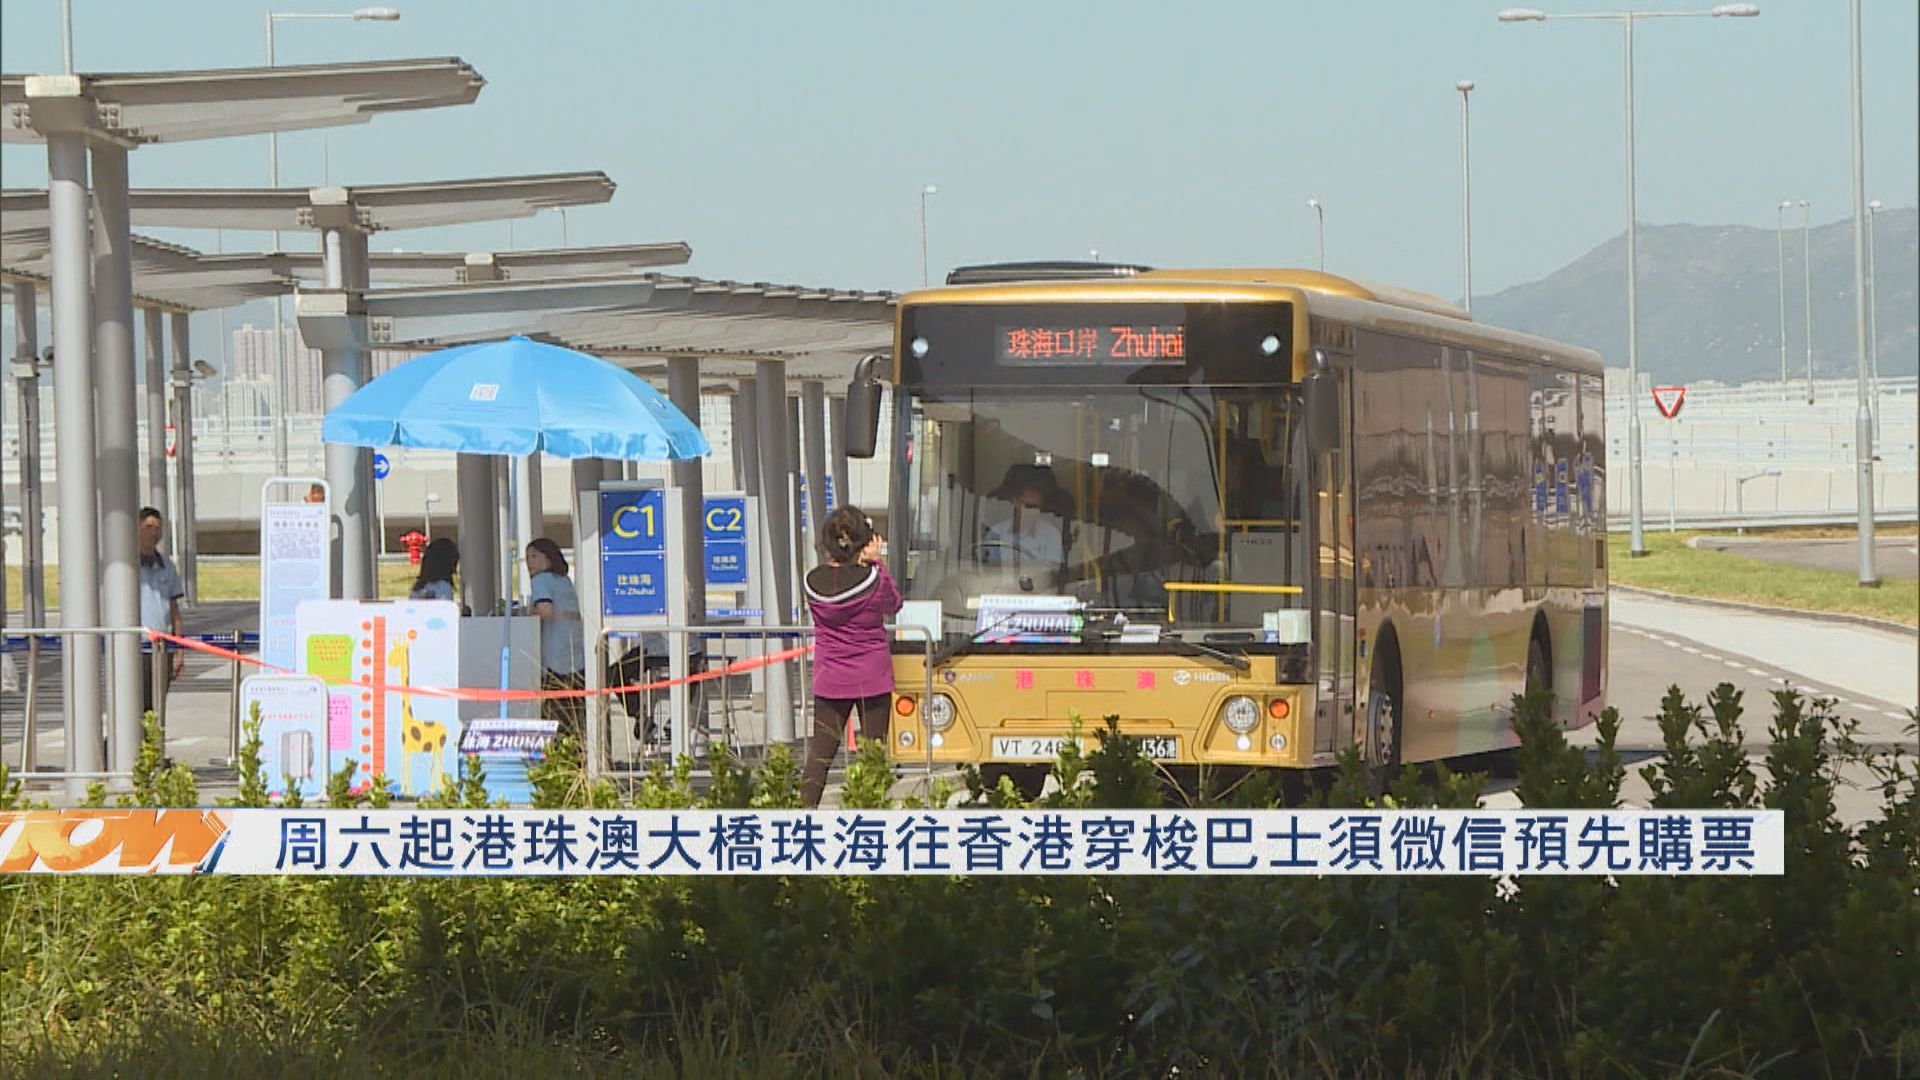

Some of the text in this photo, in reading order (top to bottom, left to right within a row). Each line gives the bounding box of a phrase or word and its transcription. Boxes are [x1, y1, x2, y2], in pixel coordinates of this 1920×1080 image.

[1007, 326, 1184, 359] 珠海口岸 Zhuhai
[611, 504, 656, 538] C1
[705, 507, 743, 532] C2
[999, 740, 1022, 756] VT
